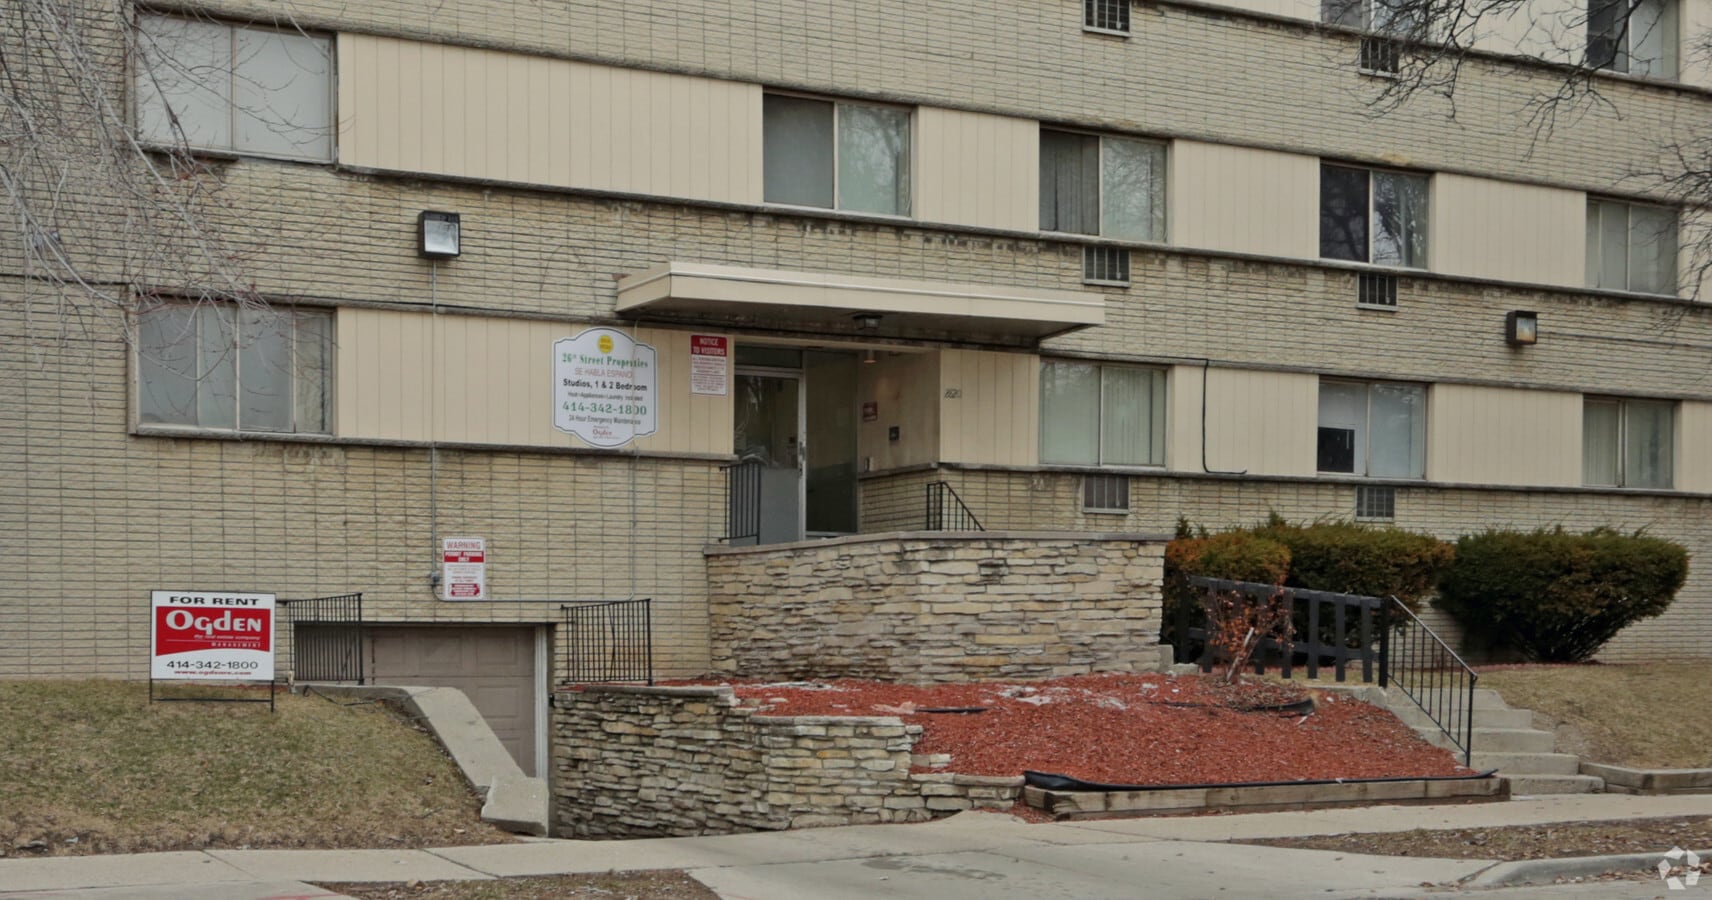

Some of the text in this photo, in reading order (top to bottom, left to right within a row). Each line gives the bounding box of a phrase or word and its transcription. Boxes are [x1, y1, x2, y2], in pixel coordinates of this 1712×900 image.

[700, 337, 719, 346] NOTICE
[693, 346, 700, 354] TO
[580, 355, 604, 366] Street
[607, 356, 648, 368] Properties
[563, 378, 593, 389] Studios,
[602, 381, 607, 390] &
[563, 401, 647, 415] 414-342-1800
[614, 417, 641, 425] Maintenace
[446, 541, 481, 550] WARNING
[212, 598, 259, 606] RENT
[166, 660, 260, 670] 414-342-1800
